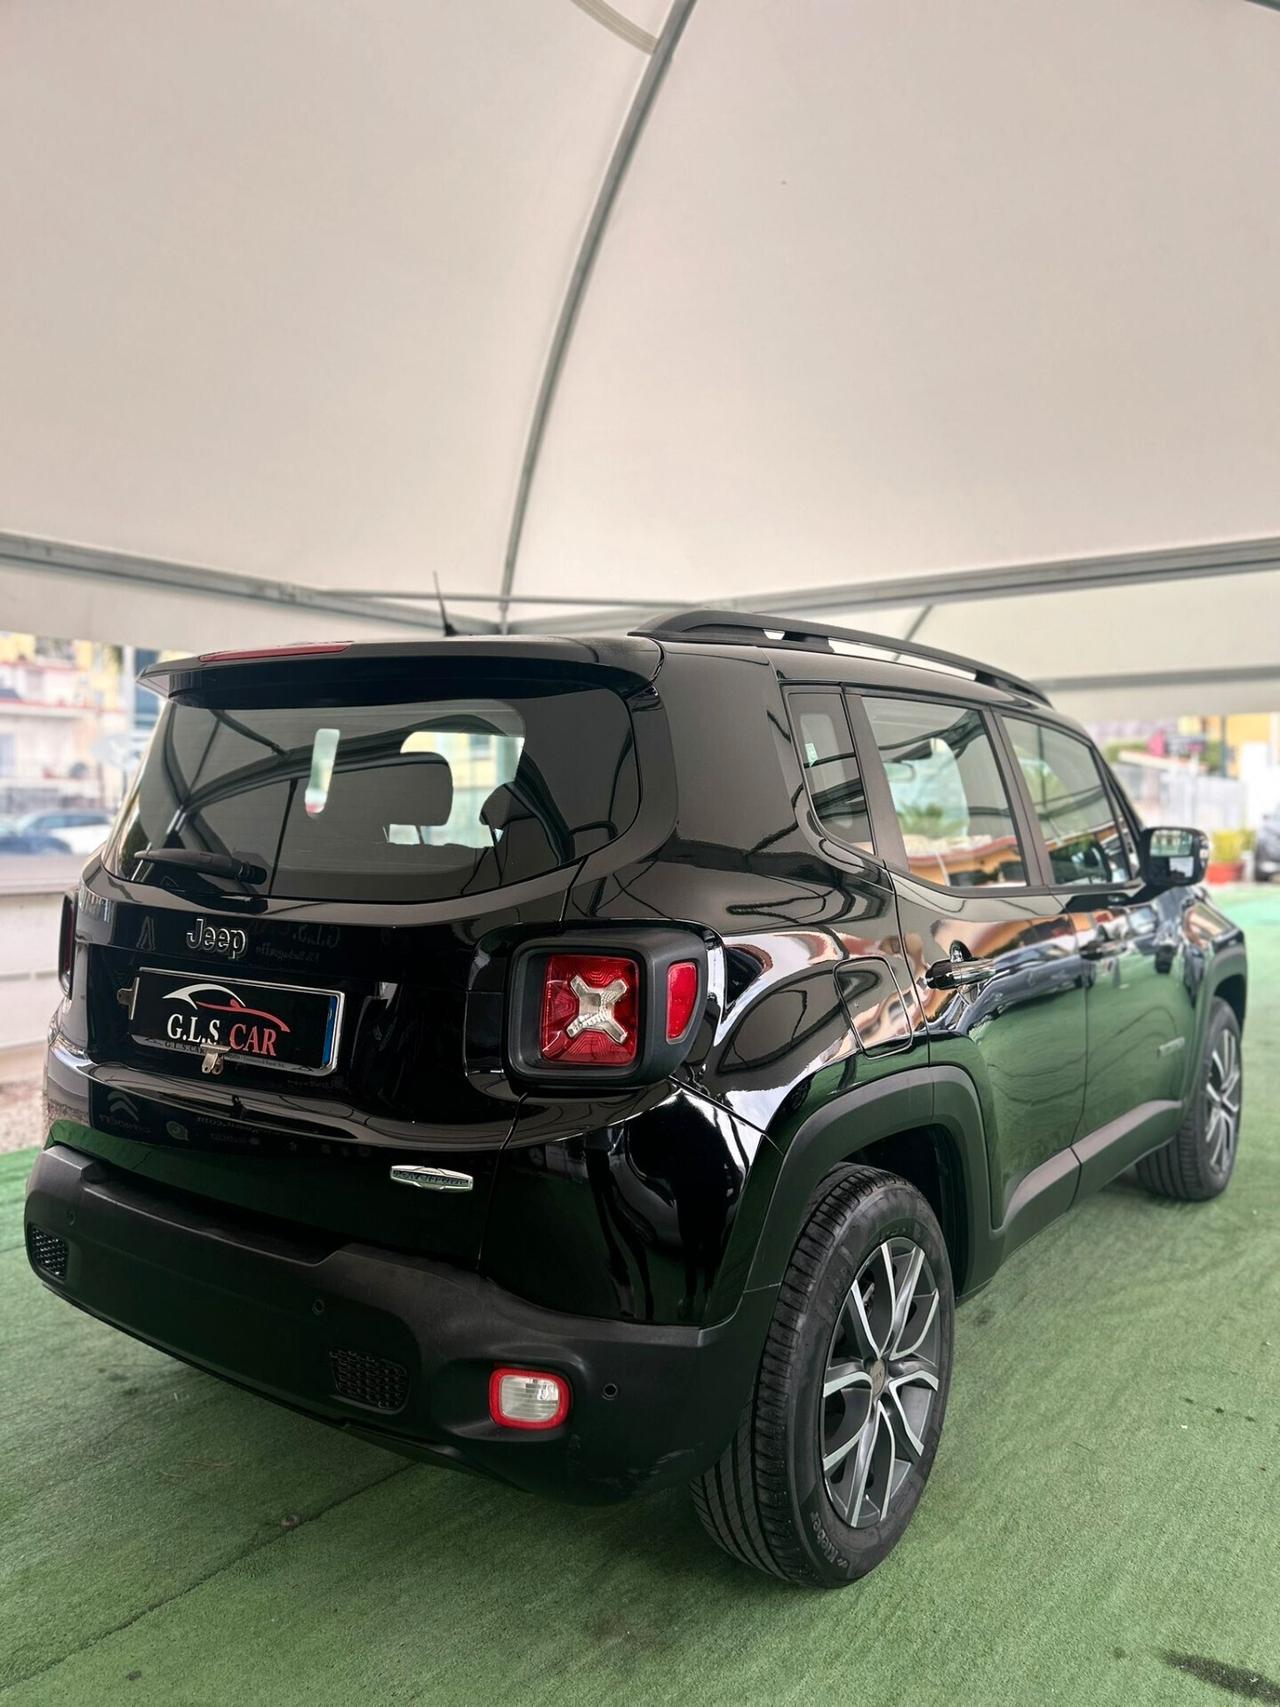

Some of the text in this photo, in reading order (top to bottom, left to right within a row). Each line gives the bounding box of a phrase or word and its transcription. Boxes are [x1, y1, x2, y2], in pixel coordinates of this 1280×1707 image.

[186, 918, 246, 959] Jeep
[166, 1013, 277, 1056] G.L.S CAR
[809, 1511, 839, 1564] Kleber
